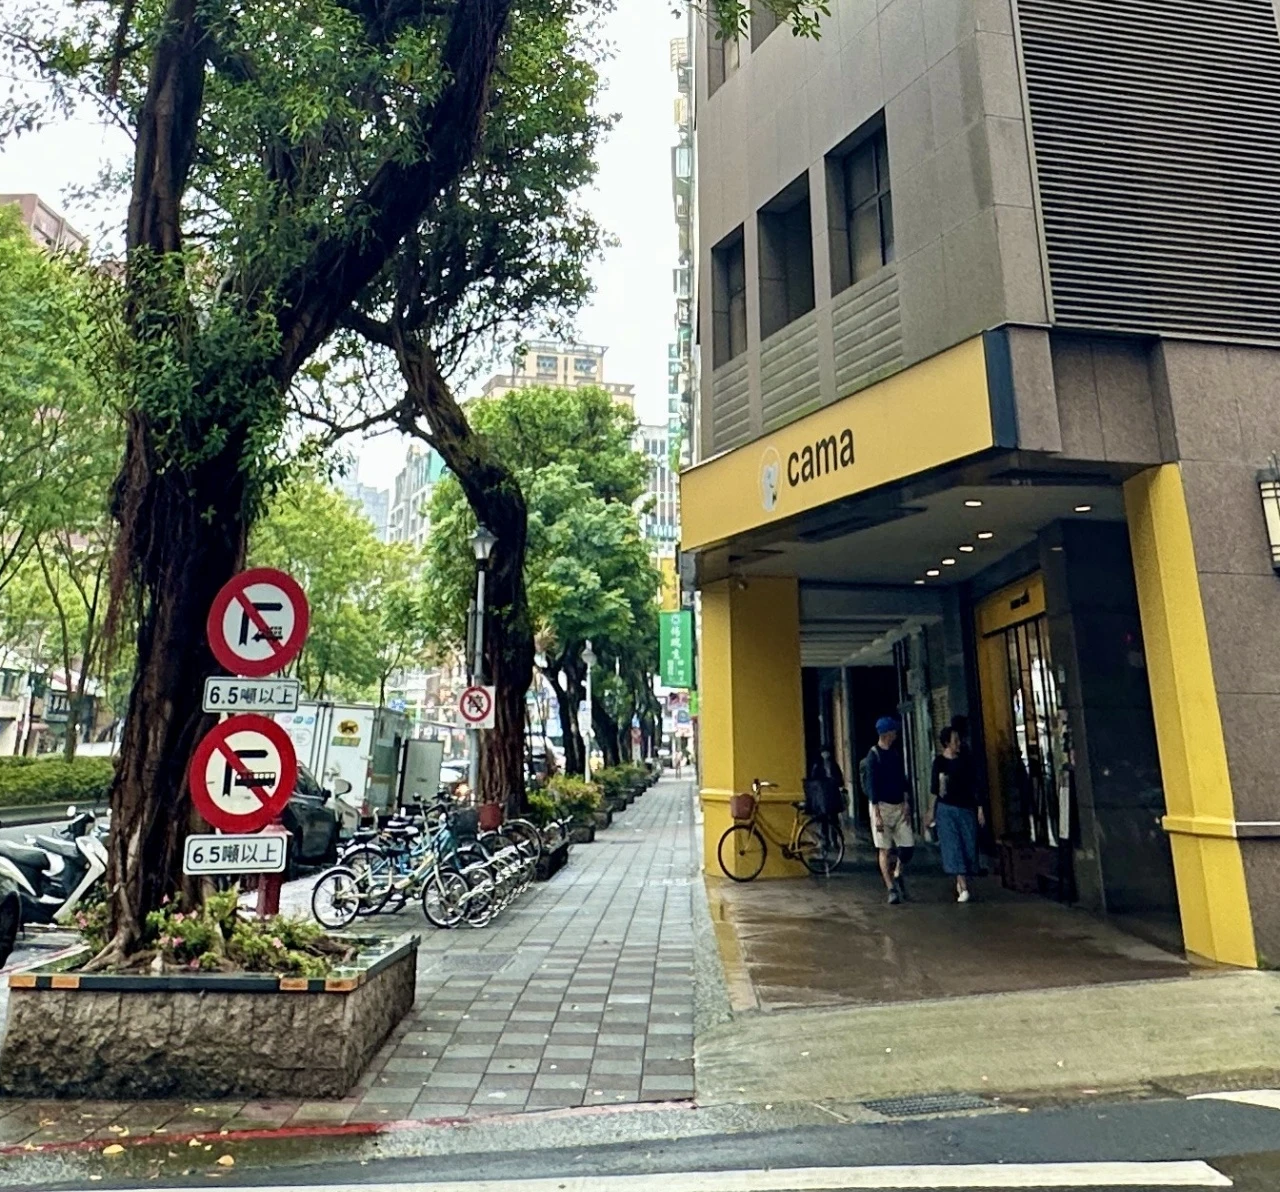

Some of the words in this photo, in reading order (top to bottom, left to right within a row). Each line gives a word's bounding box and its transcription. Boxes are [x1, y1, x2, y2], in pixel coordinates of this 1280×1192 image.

[787, 428, 855, 487] cama
[209, 686, 293, 704] 6.5噸以上
[192, 843, 277, 864] 6.5噸以上
